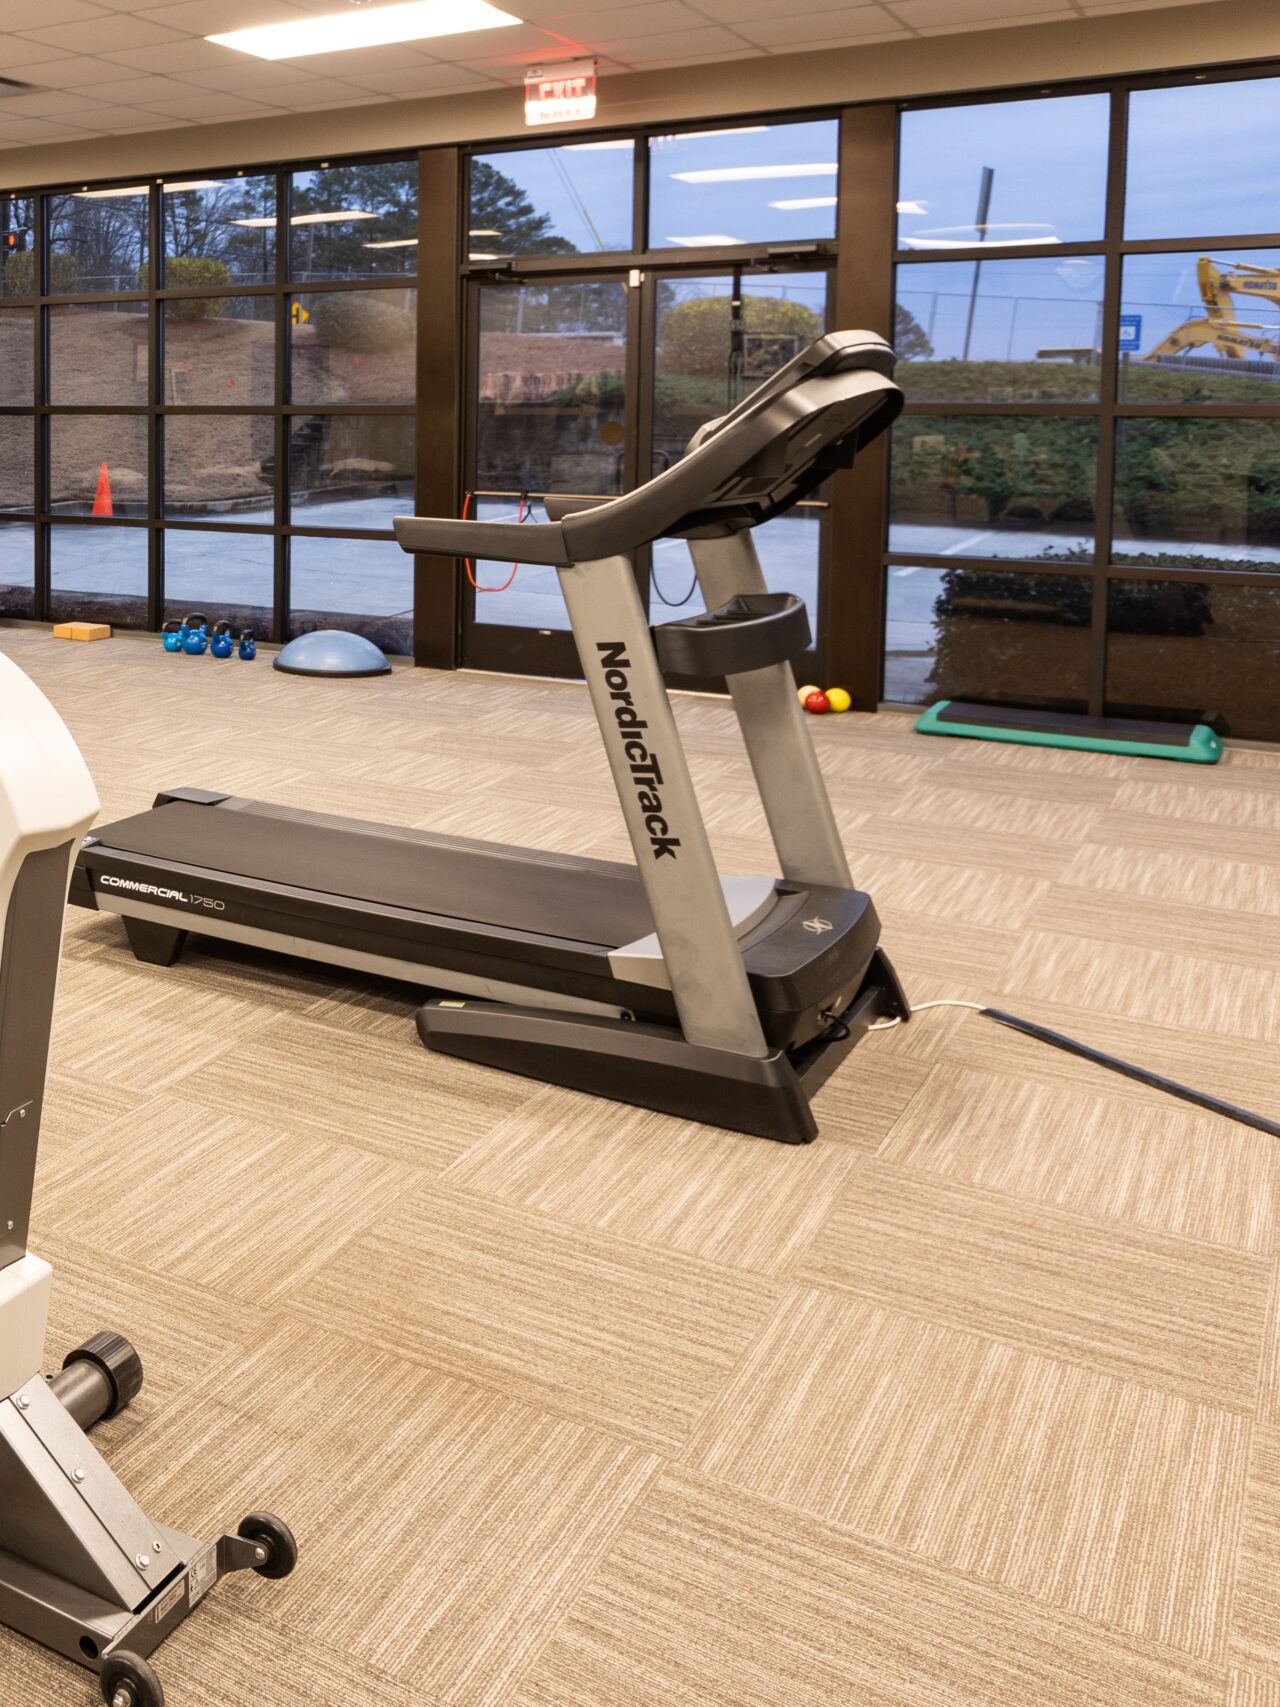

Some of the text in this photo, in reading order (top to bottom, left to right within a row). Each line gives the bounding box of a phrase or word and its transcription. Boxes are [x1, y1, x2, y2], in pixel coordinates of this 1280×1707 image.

[596, 642, 681, 860] NordicTrack
[100, 875, 225, 911] COMMERCIAL 1750
